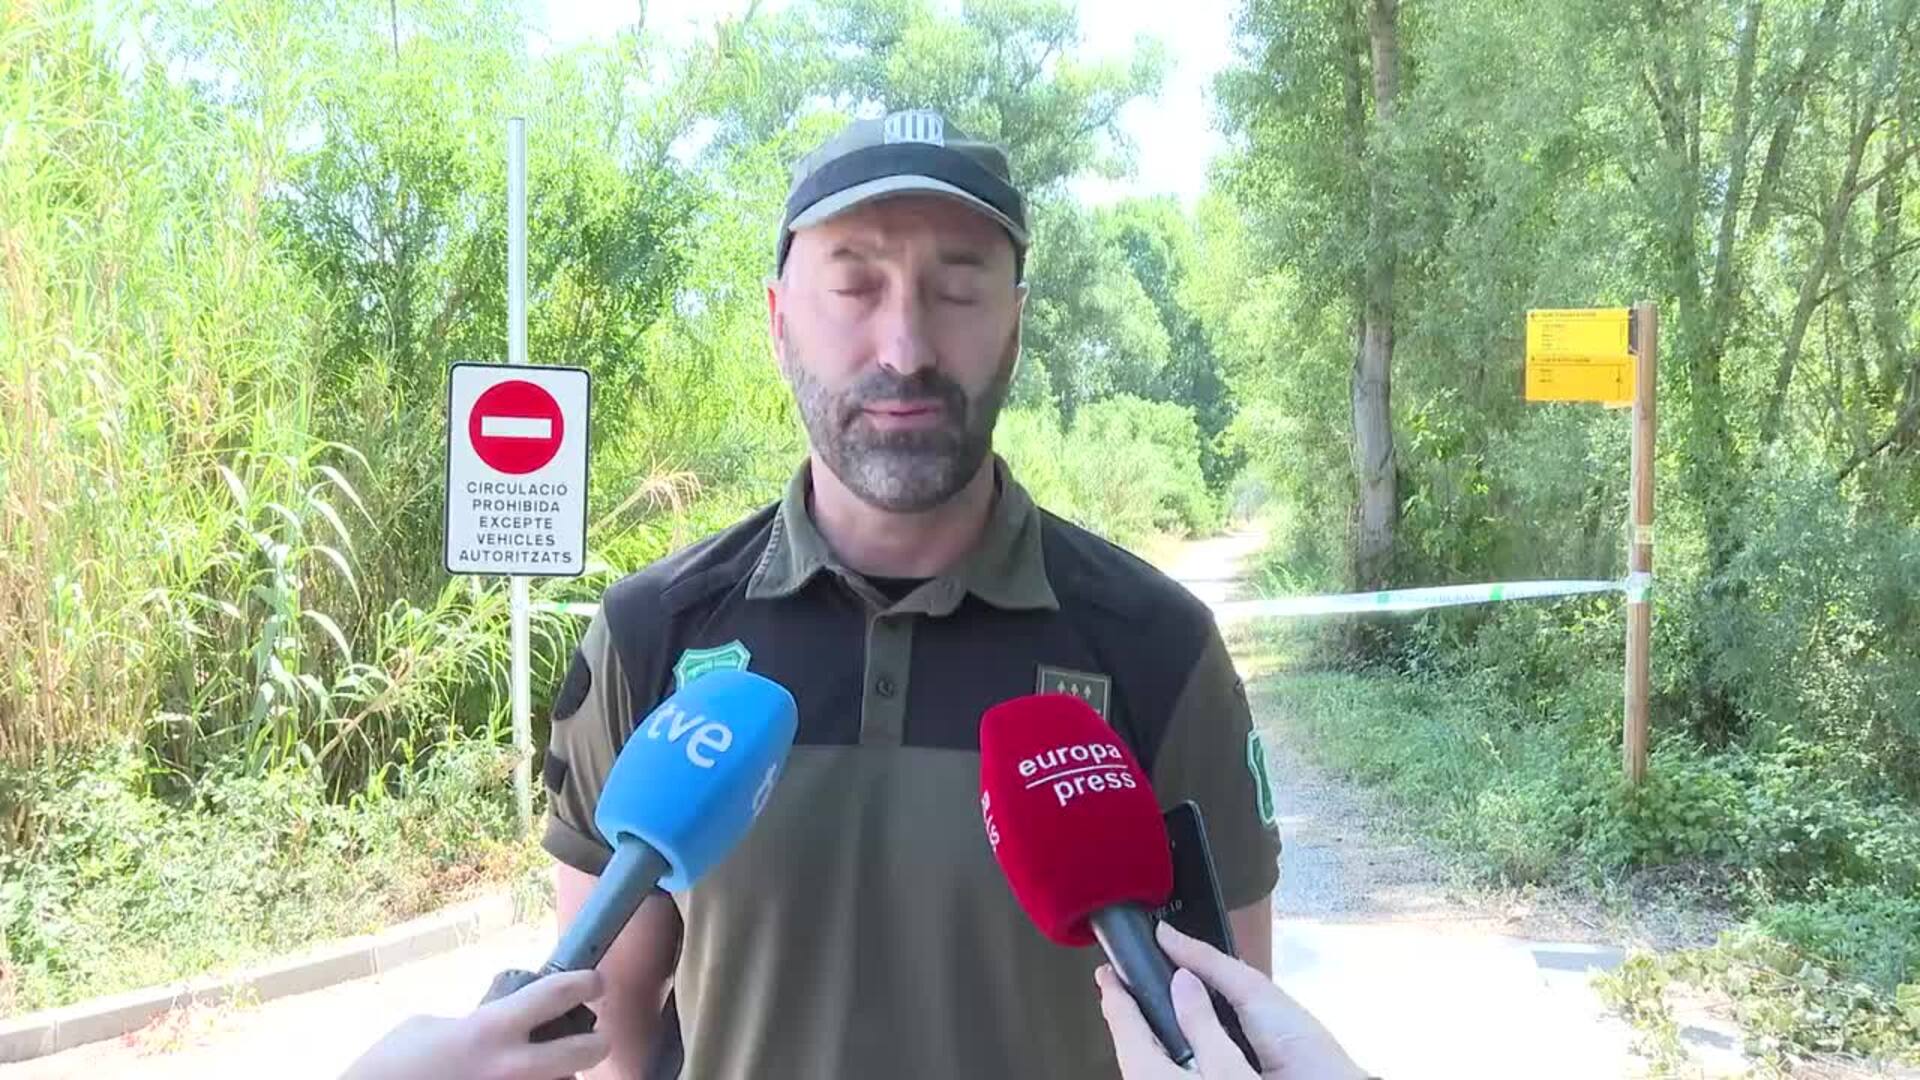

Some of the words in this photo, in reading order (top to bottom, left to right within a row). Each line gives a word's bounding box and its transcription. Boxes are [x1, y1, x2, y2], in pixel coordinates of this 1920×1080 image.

[472, 499, 559, 512] PROHIBIDA
[479, 516, 552, 529] EXCEPTE
[477, 533, 555, 546] VEHICLES
[459, 550, 572, 564] AUTORITZATS
[646, 703, 733, 769] tve
[1018, 742, 1122, 777] europa
[1053, 769, 1137, 806] press
